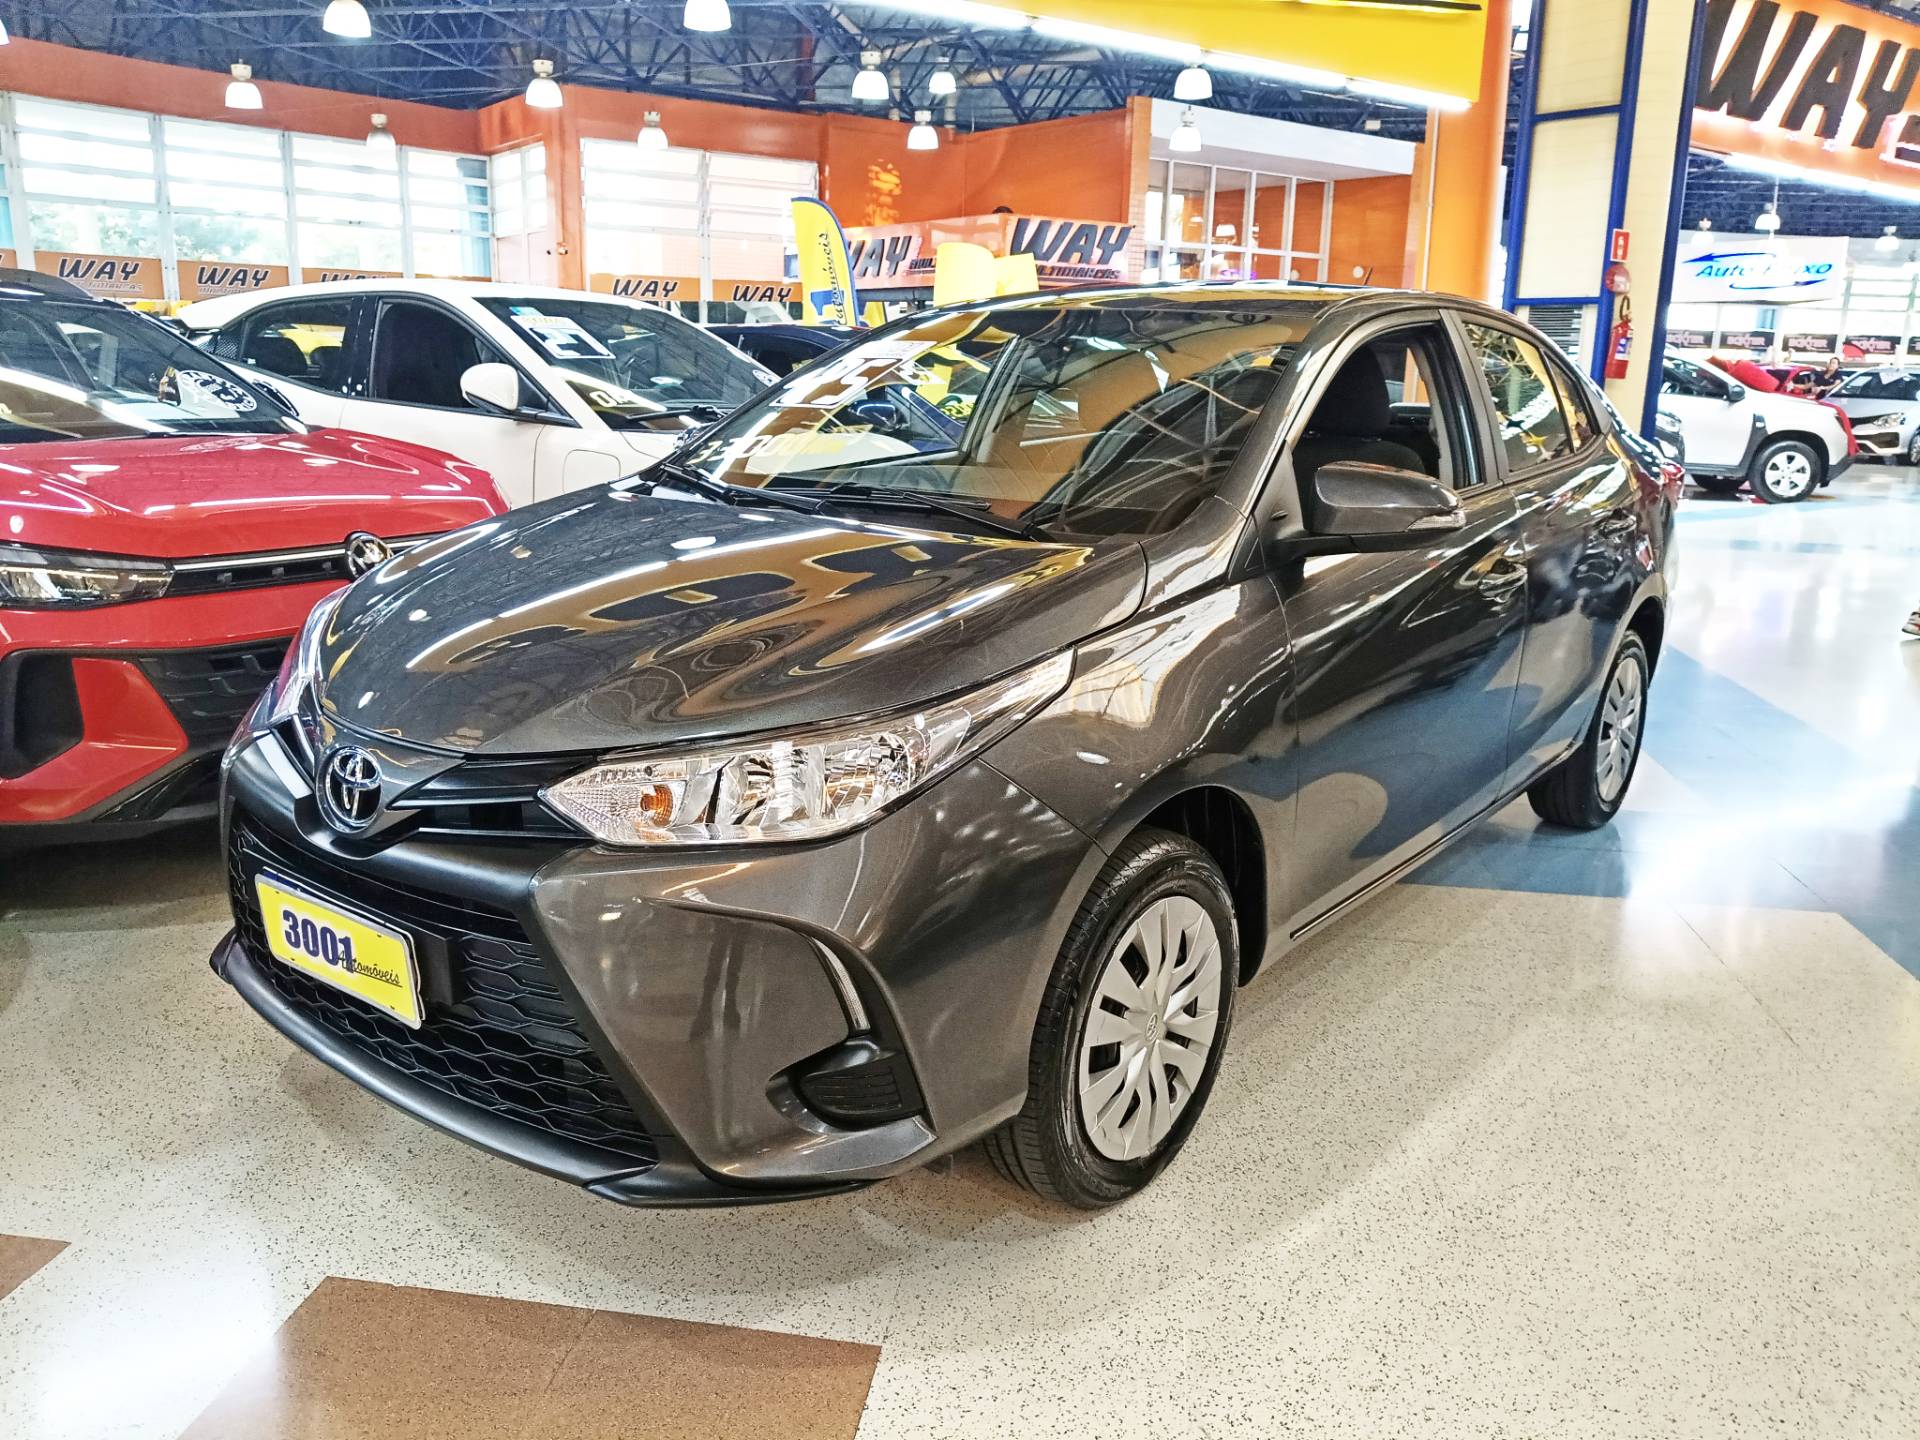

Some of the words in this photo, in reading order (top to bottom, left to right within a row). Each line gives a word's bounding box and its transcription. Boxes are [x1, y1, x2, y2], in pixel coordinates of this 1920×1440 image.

[1695, 0, 1919, 149] WAY
[1010, 217, 1132, 265] WAY
[58, 257, 140, 281] WAY
[197, 265, 270, 288] WAY
[611, 277, 679, 299] WAY
[732, 284, 793, 303] WAY
[282, 909, 355, 974] 3001
